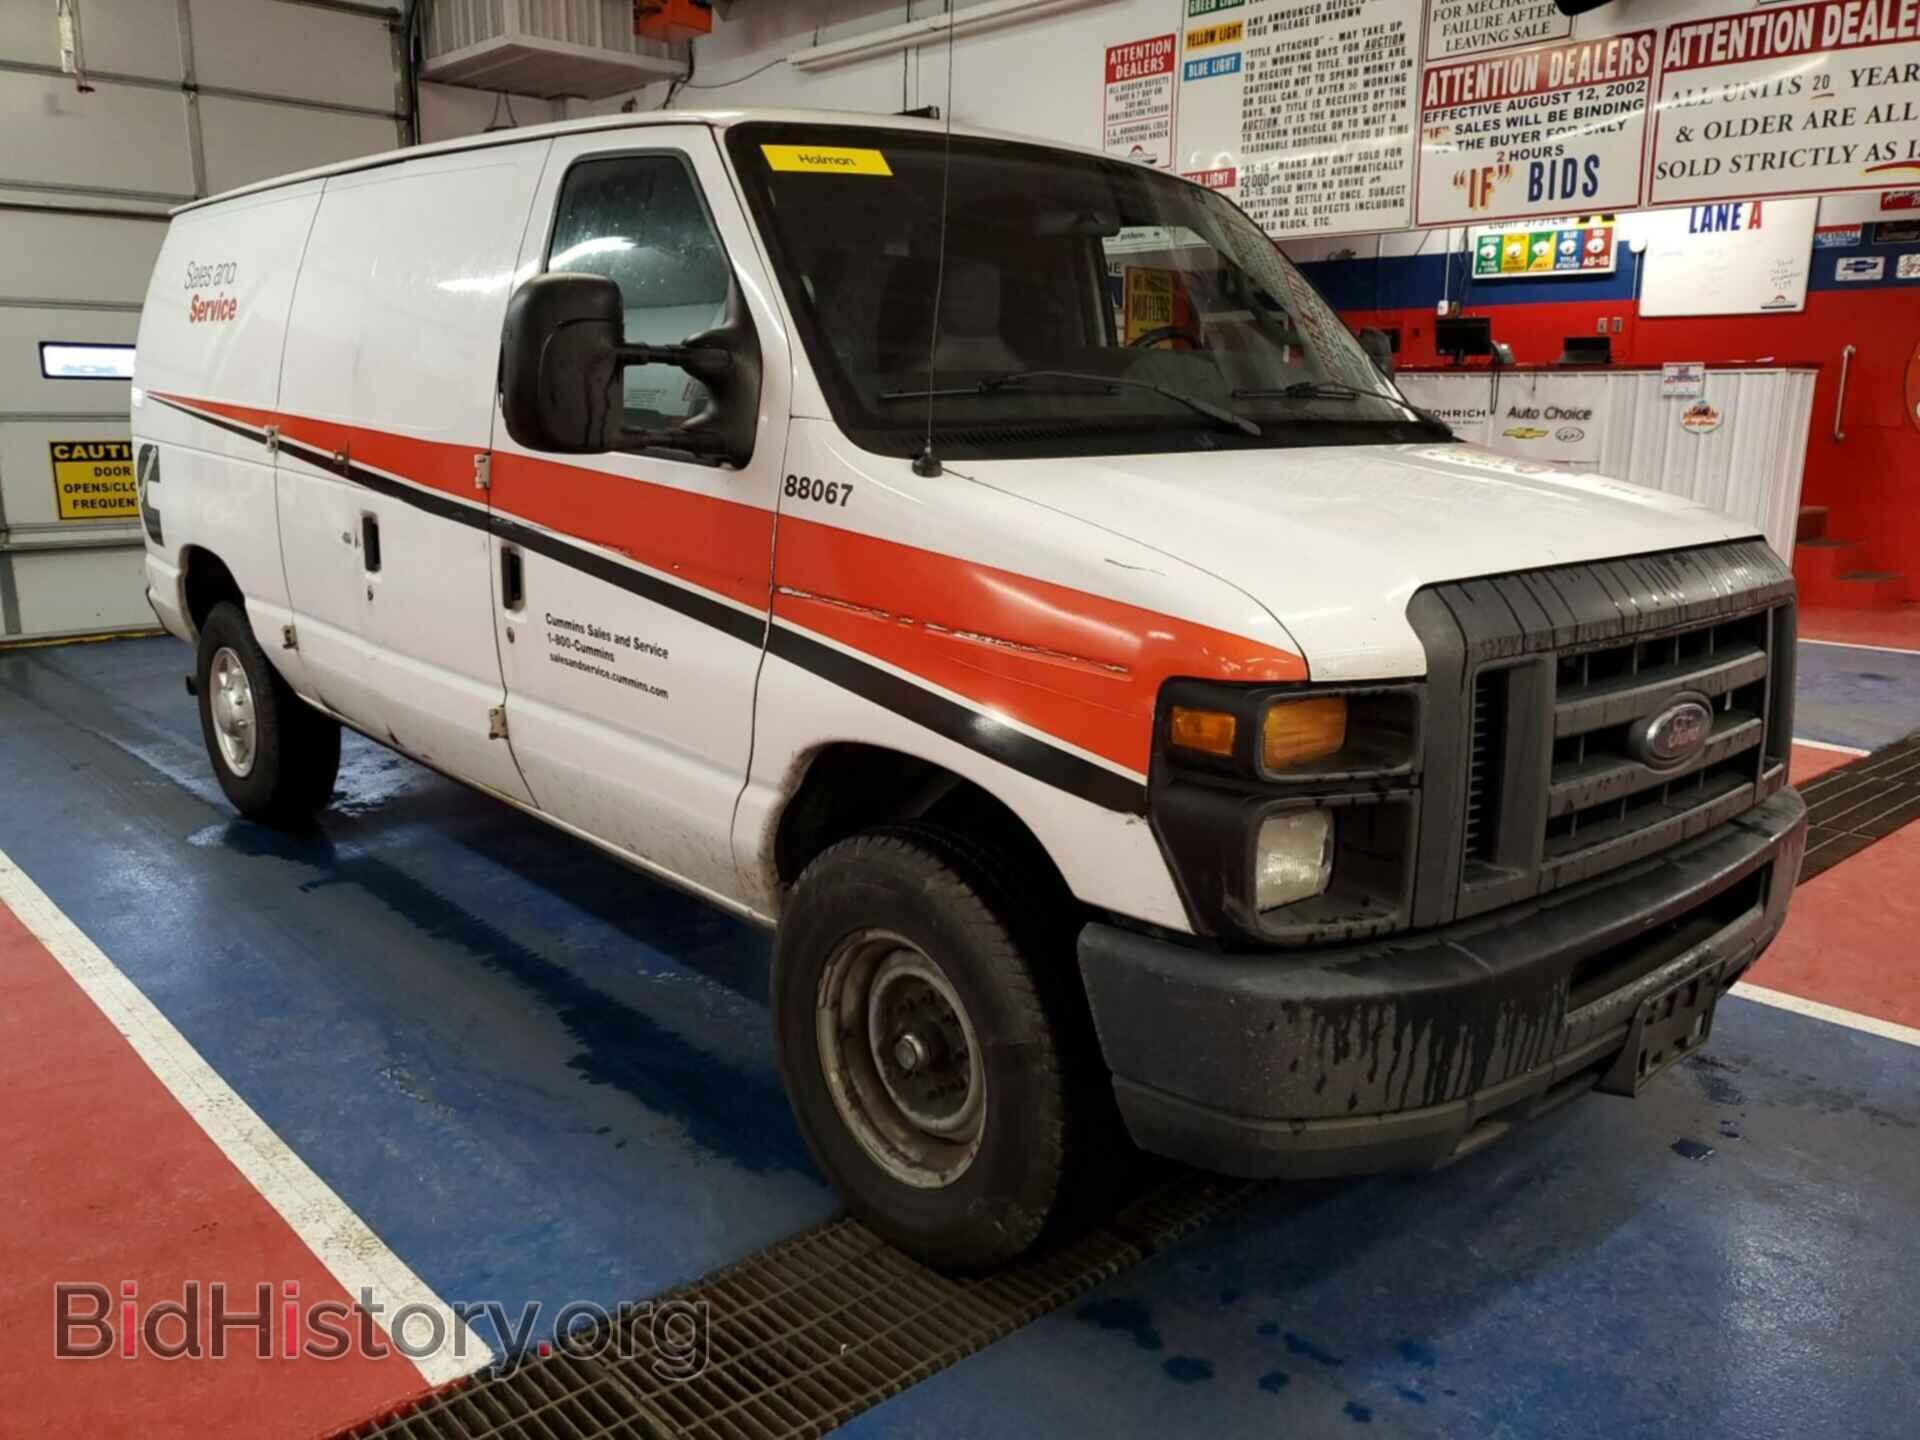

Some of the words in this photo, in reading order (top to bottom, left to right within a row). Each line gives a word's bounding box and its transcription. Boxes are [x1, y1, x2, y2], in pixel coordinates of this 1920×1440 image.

[1247, 15, 1262, 26] ANY
[1268, 3, 1320, 22] ANNOUNCED
[1247, 25, 1266, 38] TRUE
[1272, 17, 1309, 32] MILEAGE
[1314, 6, 1360, 24] UNKNOWN
[1432, 6, 1462, 22] FOR
[1442, 14, 1504, 36] FAILURE
[1507, 3, 1556, 24] AFTER
[1187, 30, 1216, 48] YELLOW
[1219, 24, 1242, 41] LIGHT
[1339, 29, 1356, 41] MAY
[1362, 24, 1383, 37] TAKE
[1389, 20, 1402, 32] UP
[1445, 29, 1509, 52] LEAVING
[1513, 22, 1551, 40] SALE
[1664, 8, 1816, 69] ATTENTION
[1820, 0, 1920, 48] DEALE
[1110, 38, 1172, 64] ATTENTION
[1244, 72, 1253, 82] TO
[1259, 66, 1291, 80] RECEIVE
[1297, 62, 1311, 74] THE
[1348, 50, 1382, 65] BUYERS
[1388, 46, 1404, 58] ARE
[1245, 60, 1255, 71] TO
[1271, 50, 1311, 66] WORKING
[1316, 45, 1337, 58] DAYS
[1343, 41, 1358, 53] FOR
[1365, 31, 1405, 50] AUCTION
[1116, 56, 1165, 79] DEALERS
[1188, 60, 1208, 78] BLUE
[1212, 55, 1236, 74] LIGHT
[1243, 78, 1289, 94] CAUTIONED
[1294, 75, 1309, 86] NOT
[1315, 72, 1325, 83] TO
[1329, 67, 1357, 80] SPEND
[1364, 61, 1394, 74] MONEY
[1400, 58, 1412, 69] ON
[1425, 52, 1540, 107] ATTENTION
[1550, 33, 1650, 88] DEALERS
[1243, 96, 1253, 106] OR
[1258, 93, 1276, 104] SELL
[1305, 87, 1311, 96] IF
[1318, 82, 1343, 95] AFTER
[1363, 71, 1406, 87] WORKING
[1812, 74, 1831, 91] 20
[1271, 104, 1281, 114] NO
[1286, 100, 1306, 112] TITLE
[1312, 98, 1320, 108] IS
[1326, 91, 1368, 106] RECEIVED
[1373, 88, 1384, 99] BY
[1390, 85, 1405, 97] THE
[1284, 114, 1291, 124] IT
[1296, 112, 1304, 122] IS
[1310, 110, 1324, 121] THE
[1330, 103, 1367, 117] BUYER'S
[1372, 98, 1405, 112] OPTION
[1424, 102, 1502, 124] EFFECTIVE
[1506, 92, 1571, 114] AUGUST
[1576, 88, 1600, 104] 12,
[1606, 80, 1646, 98] 2002
[1241, 132, 1250, 142] TO
[1256, 127, 1287, 140] RETURN
[1293, 122, 1325, 135] VEHICLE
[1332, 120, 1343, 130] OR
[1348, 118, 1357, 128] TO
[1363, 114, 1385, 126] WAIT
[1391, 112, 1395, 122] A
[1455, 119, 1501, 136] SALES
[1506, 112, 1542, 130] WILL
[1548, 109, 1568, 124] BE
[1574, 98, 1644, 120] BINDING
[1676, 126, 1694, 144] &
[1704, 113, 1793, 141] OLDER
[1802, 107, 1857, 130] ARE
[1864, 102, 1919, 124] ALL
[1241, 139, 1287, 154] REASONABLE
[1292, 133, 1336, 147] ADDITIONAL
[1341, 128, 1370, 141] PERIOD
[1375, 127, 1383, 137] OF
[1388, 123, 1408, 135] TIME
[1456, 134, 1485, 150] THE
[1490, 128, 1541, 148] BUYER
[798, 154, 857, 166] Holman
[1278, 158, 1306, 170] MEANS
[1311, 155, 1327, 166] ANY
[1332, 152, 1353, 164] UNIT
[1358, 149, 1379, 161] SOLD
[1384, 146, 1401, 158] FOR
[1496, 151, 1505, 163] 2
[1508, 144, 1564, 161] HOURS
[1656, 157, 1721, 180] SOLD
[1729, 144, 1859, 174] STRICTLY
[1864, 140, 1898, 162] AS
[1907, 140, 1920, 159] I
[1284, 169, 1312, 181] UNDER
[1317, 168, 1325, 178] IS
[1331, 159, 1403, 176] AUTOMATICALLY
[1453, 164, 1512, 209] "IF"
[1528, 154, 1600, 203] BIDS
[1271, 184, 1291, 194] SOLD
[1296, 181, 1316, 192] WITH
[1322, 180, 1333, 189] NO
[1338, 176, 1363, 188] DRIVE
[1295, 193, 1321, 205] SETTLE
[1327, 192, 1335, 201] AT
[1368, 184, 1404, 197] SUBJECT
[1253, 210, 1267, 220] ANY
[1273, 208, 1289, 218] AND
[1294, 206, 1307, 216] ALL
[1312, 202, 1349, 214] DEFECTS
[1355, 197, 1404, 211] INCLUDING
[1688, 202, 1742, 234] LANE
[1747, 200, 1762, 229] A
[184, 260, 213, 290] Sales
[214, 262, 237, 286] and
[190, 291, 237, 323] Service
[1507, 406, 1540, 420] Auto
[1544, 406, 1592, 420] Choice
[54, 444, 130, 459] CAUTI
[94, 466, 131, 477] DOOR
[64, 482, 136, 494] OPENS/CLO
[784, 474, 854, 507] 88067
[72, 498, 138, 510] FREQUEN
[546, 612, 585, 634] Cummins
[587, 624, 611, 642] Sales
[614, 632, 631, 648] and
[633, 637, 669, 660] Service
[548, 632, 615, 662] 1-800-Cummins
[549, 652, 669, 699] salesandservice.cummins.com
